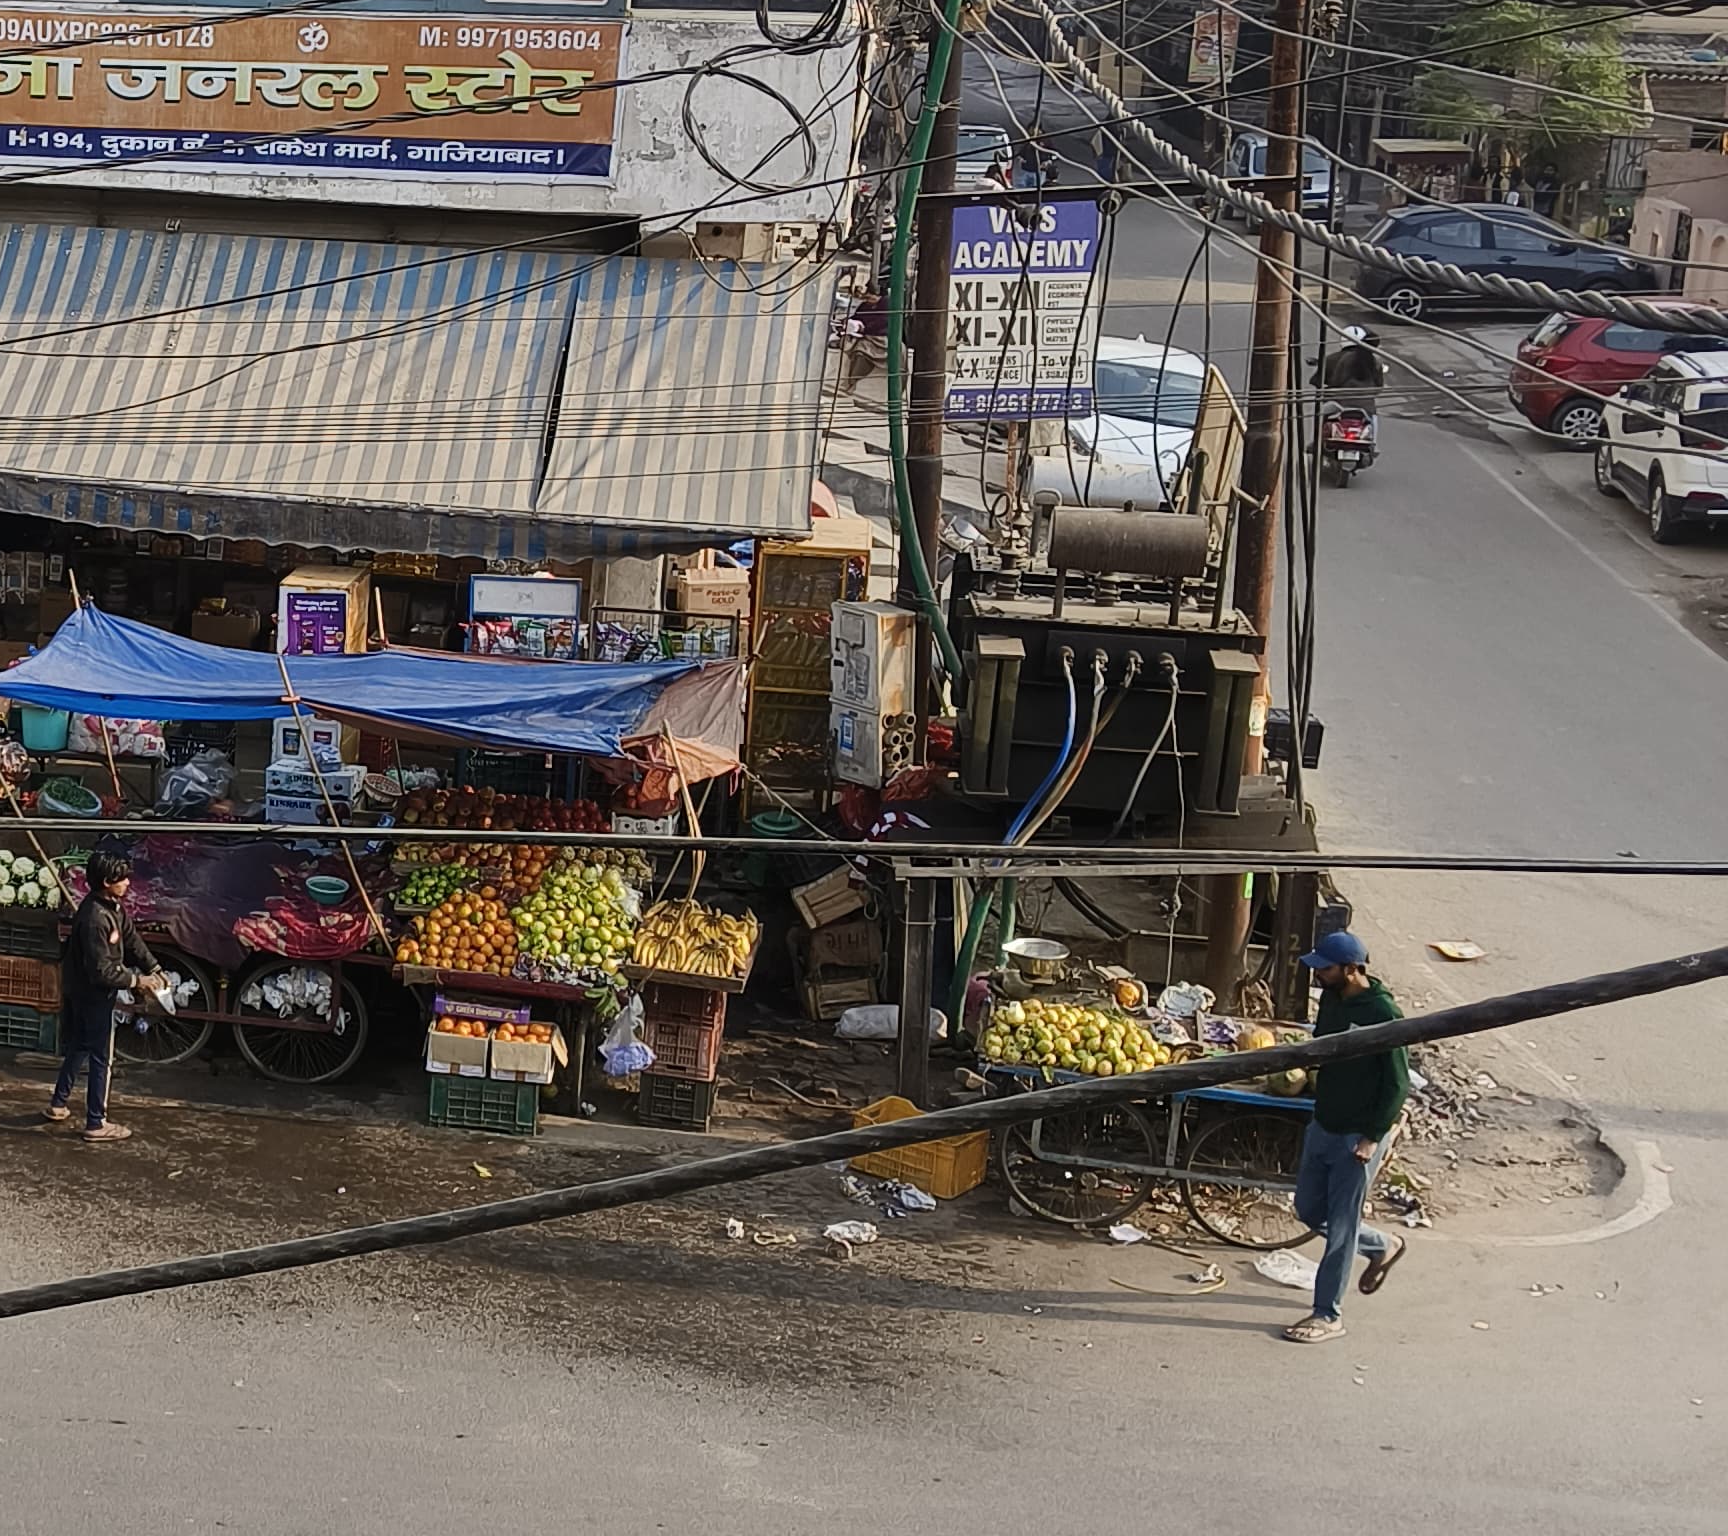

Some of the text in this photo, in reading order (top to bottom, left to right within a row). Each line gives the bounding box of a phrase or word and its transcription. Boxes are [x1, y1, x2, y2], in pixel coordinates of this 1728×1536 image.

[418, 25, 602, 52] M: 9971953604
[99, 57, 389, 112] जनरल
[403, 49, 596, 116] स्टोर
[100, 133, 177, 160] दुकान
[987, 204, 1058, 234] VS
[953, 239, 1091, 270] ACADEMY
[984, 368, 1020, 381] SCENCE
